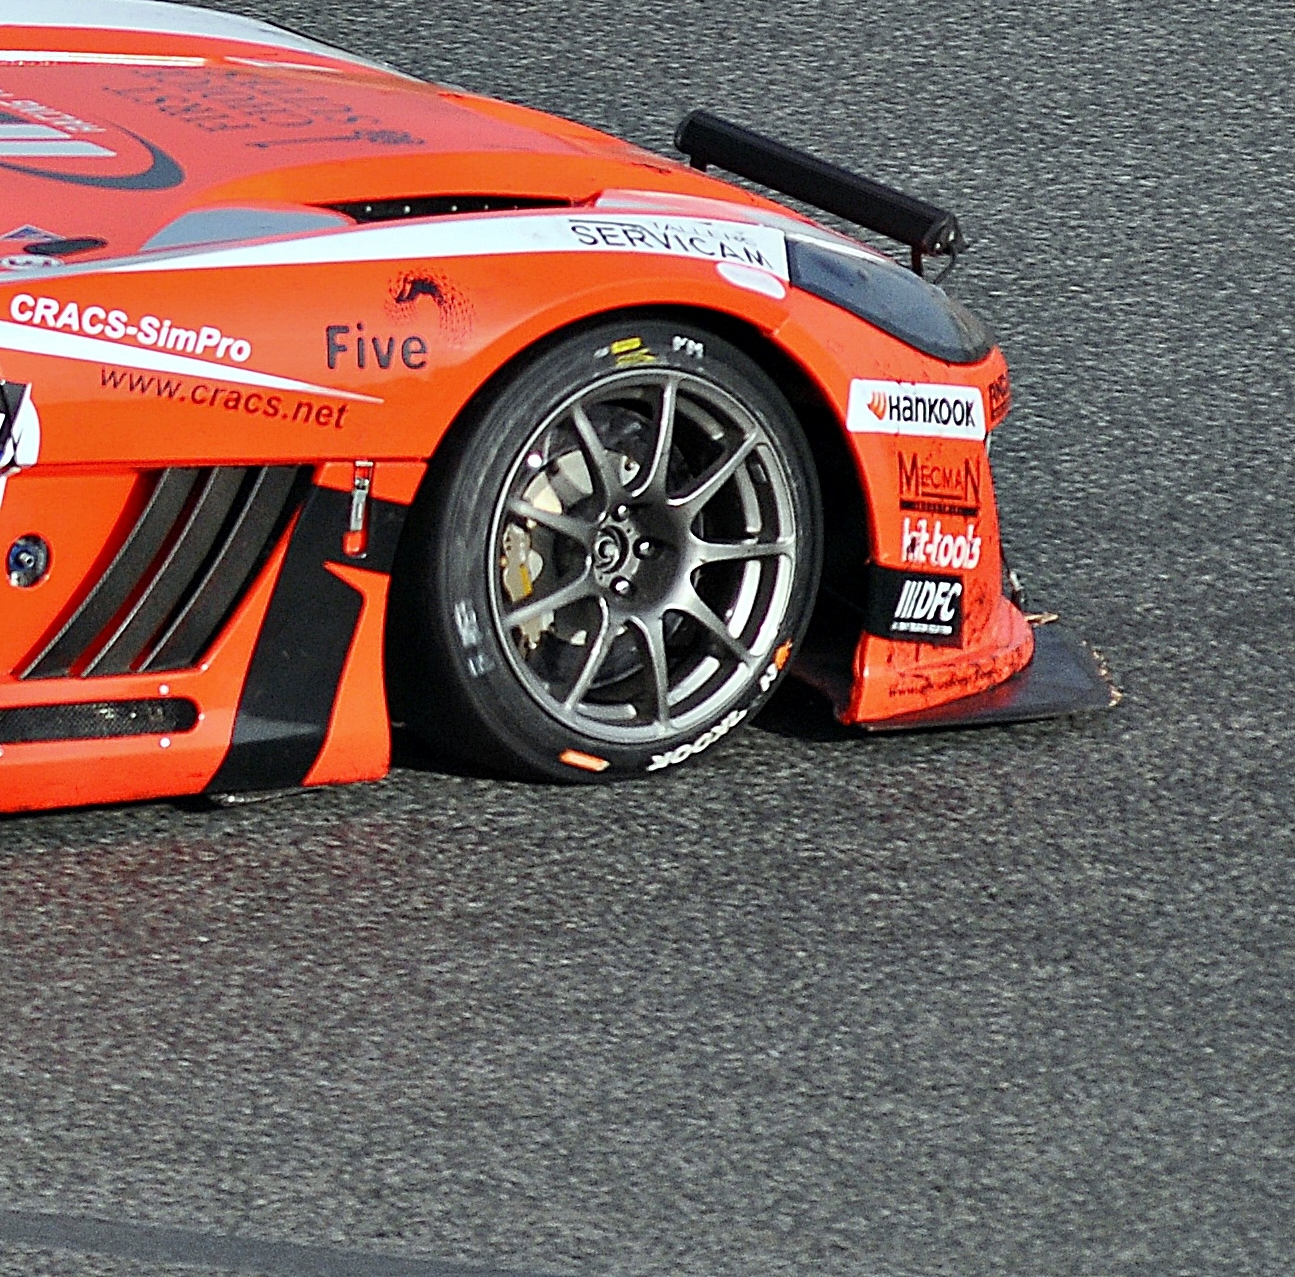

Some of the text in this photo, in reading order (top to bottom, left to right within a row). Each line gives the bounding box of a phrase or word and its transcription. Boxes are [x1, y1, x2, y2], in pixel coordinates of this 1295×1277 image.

[570, 224, 774, 271] SERVICAM
[11, 293, 252, 363] CRACS-SimPro
[325, 322, 428, 370] Five
[100, 367, 349, 430] www.cracs.net
[901, 517, 982, 570] kit-tools
